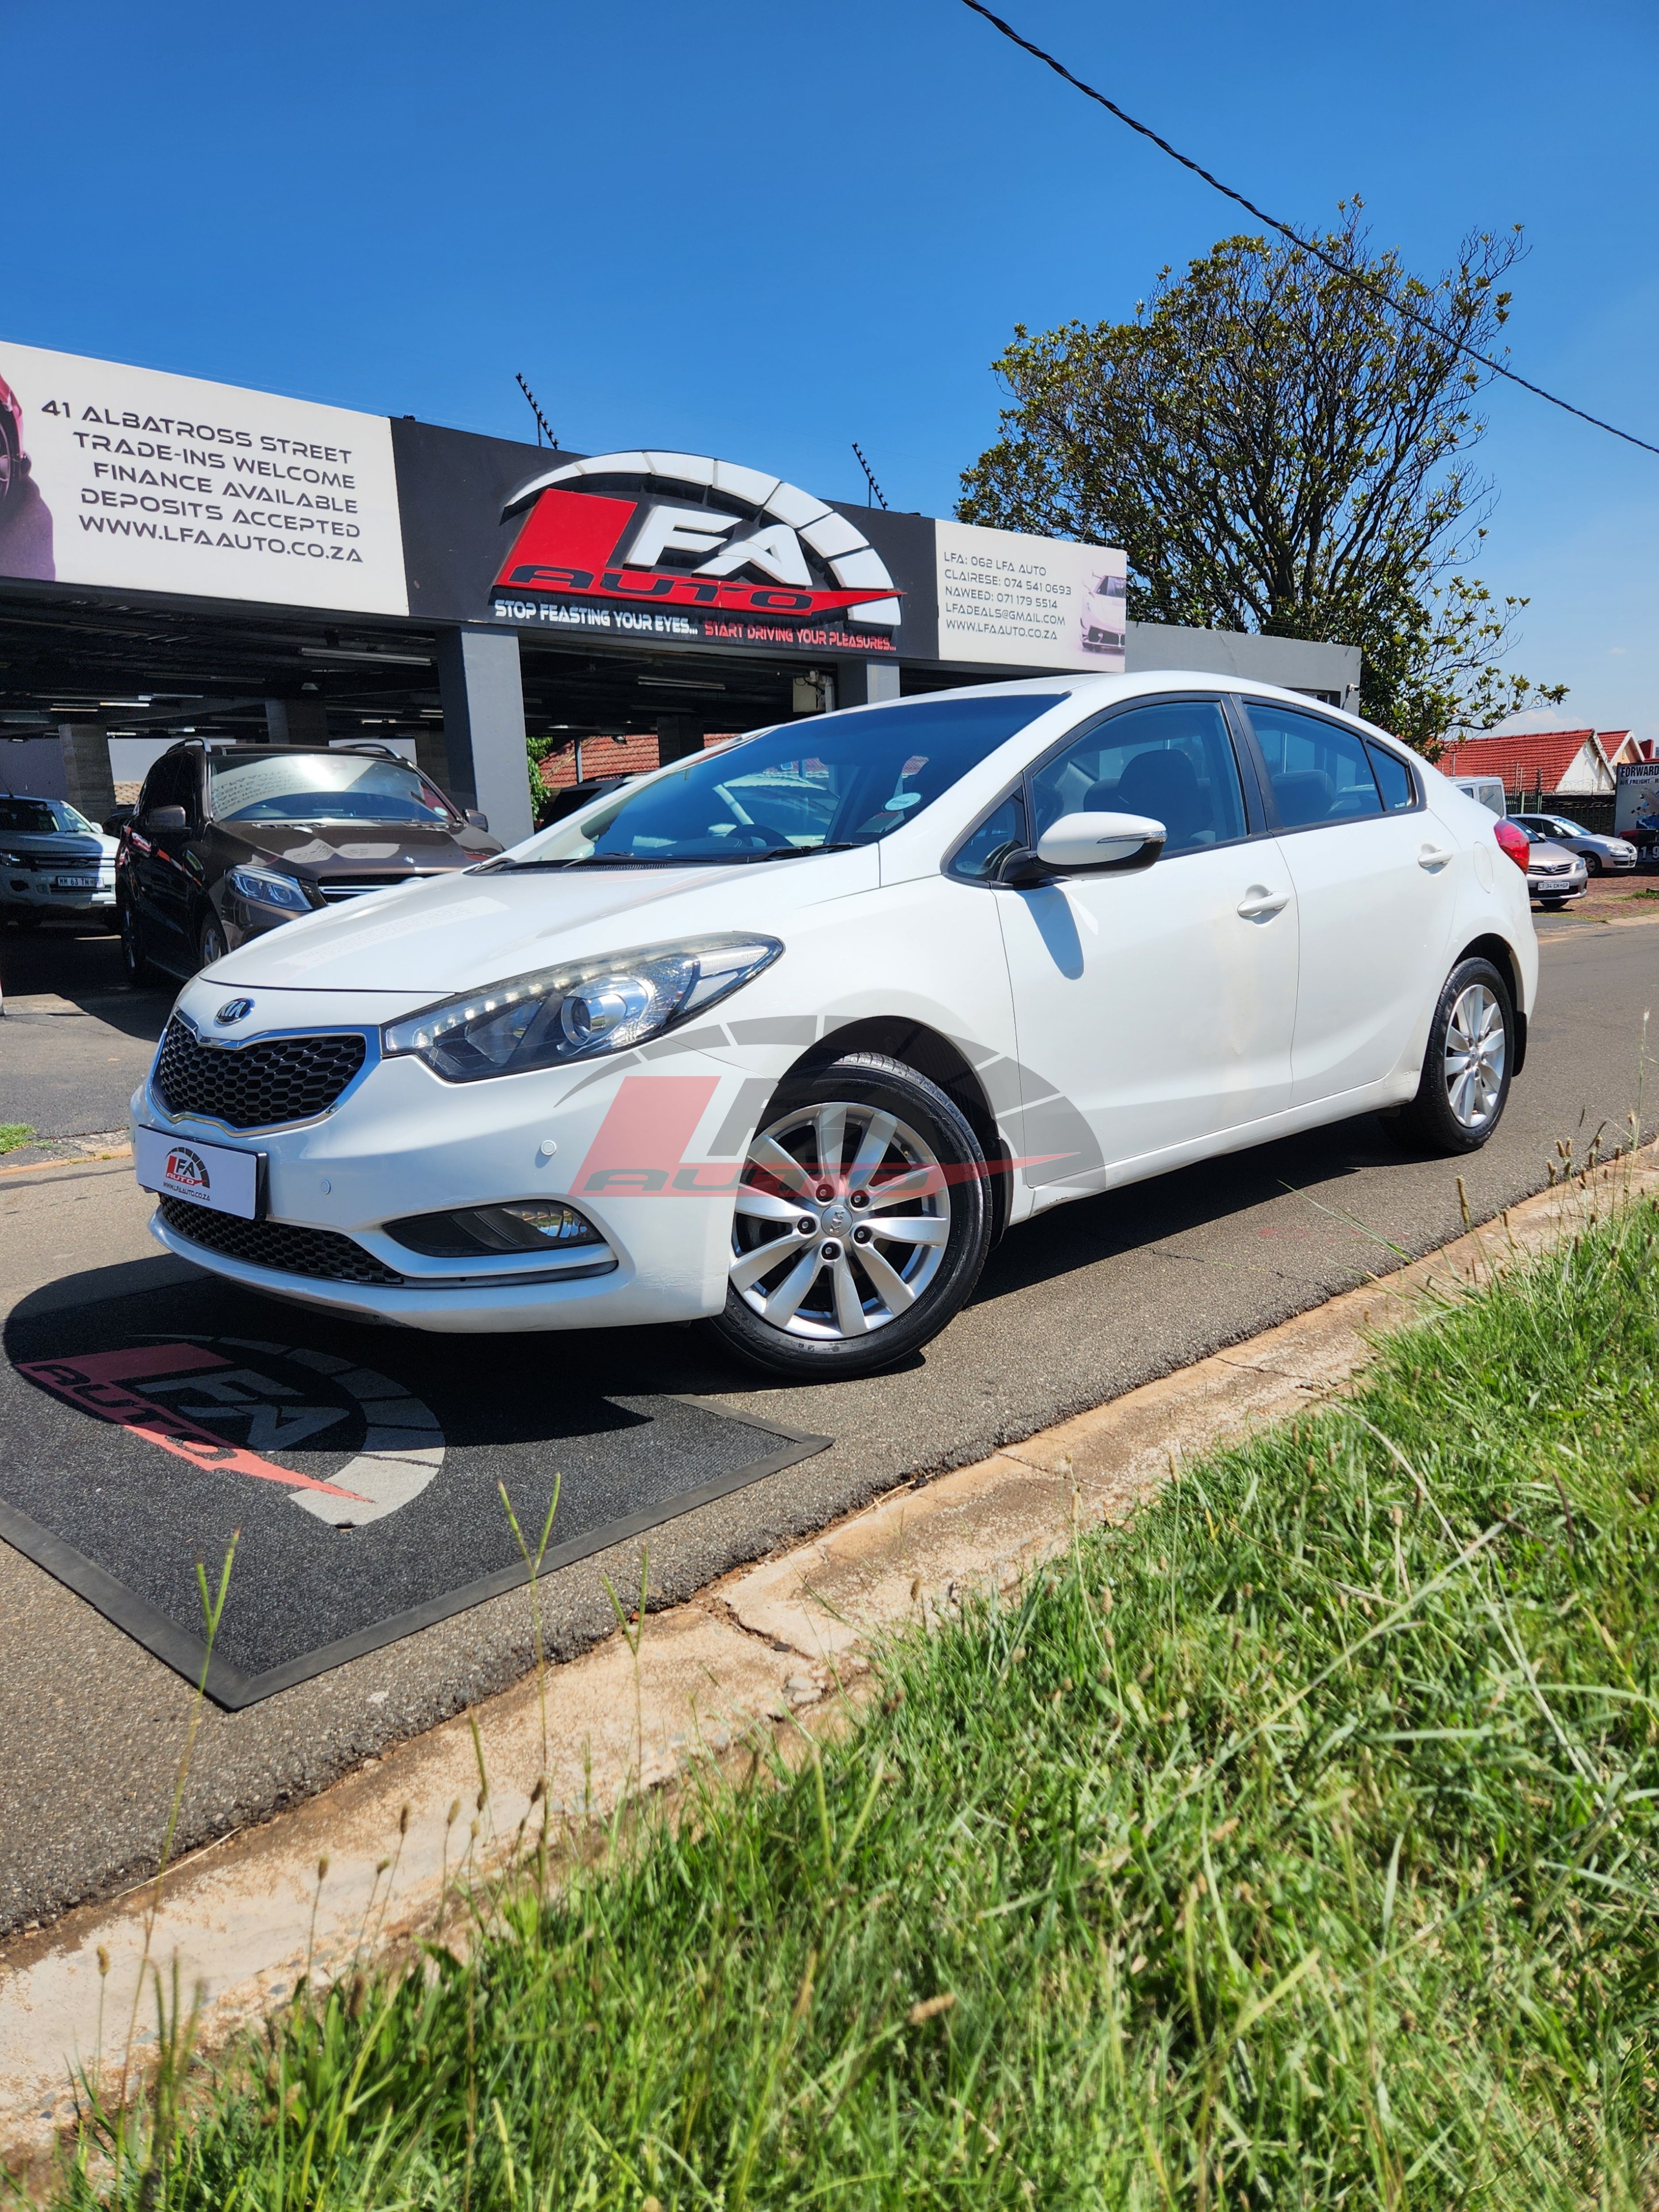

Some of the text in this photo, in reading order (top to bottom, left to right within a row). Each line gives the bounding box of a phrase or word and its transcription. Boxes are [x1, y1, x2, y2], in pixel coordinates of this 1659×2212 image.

[42, 400, 352, 464] 41 ALBATROSS STREET
[72, 432, 356, 489] TRADE-INS WELCOME
[93, 462, 358, 514] FINANCE AVAILABLE
[81, 489, 361, 538] DEPOSITS ACCEPTED
[79, 515, 364, 563] WWW.LFAAUTO.CO.ZA
[944, 552, 1046, 576] LFA: 062 LFA AUTO
[509, 565, 813, 609] AUTO
[945, 569, 1071, 595] CLAIRESE: 074 541 0693
[946, 586, 1058, 609] NAWEED: 071 179 5514
[495, 600, 897, 651] STOP FEASTING YOUR EYES... START DRIVING YOUR PLEASURES...
[946, 603, 1065, 626] LFADEALS@GMAIL.COM
[947, 619, 1058, 640] WWW.LFAAUTO.CO.ZA
[1621, 766, 1659, 777] FORWARD
[166, 1173, 194, 1185] AUTO
